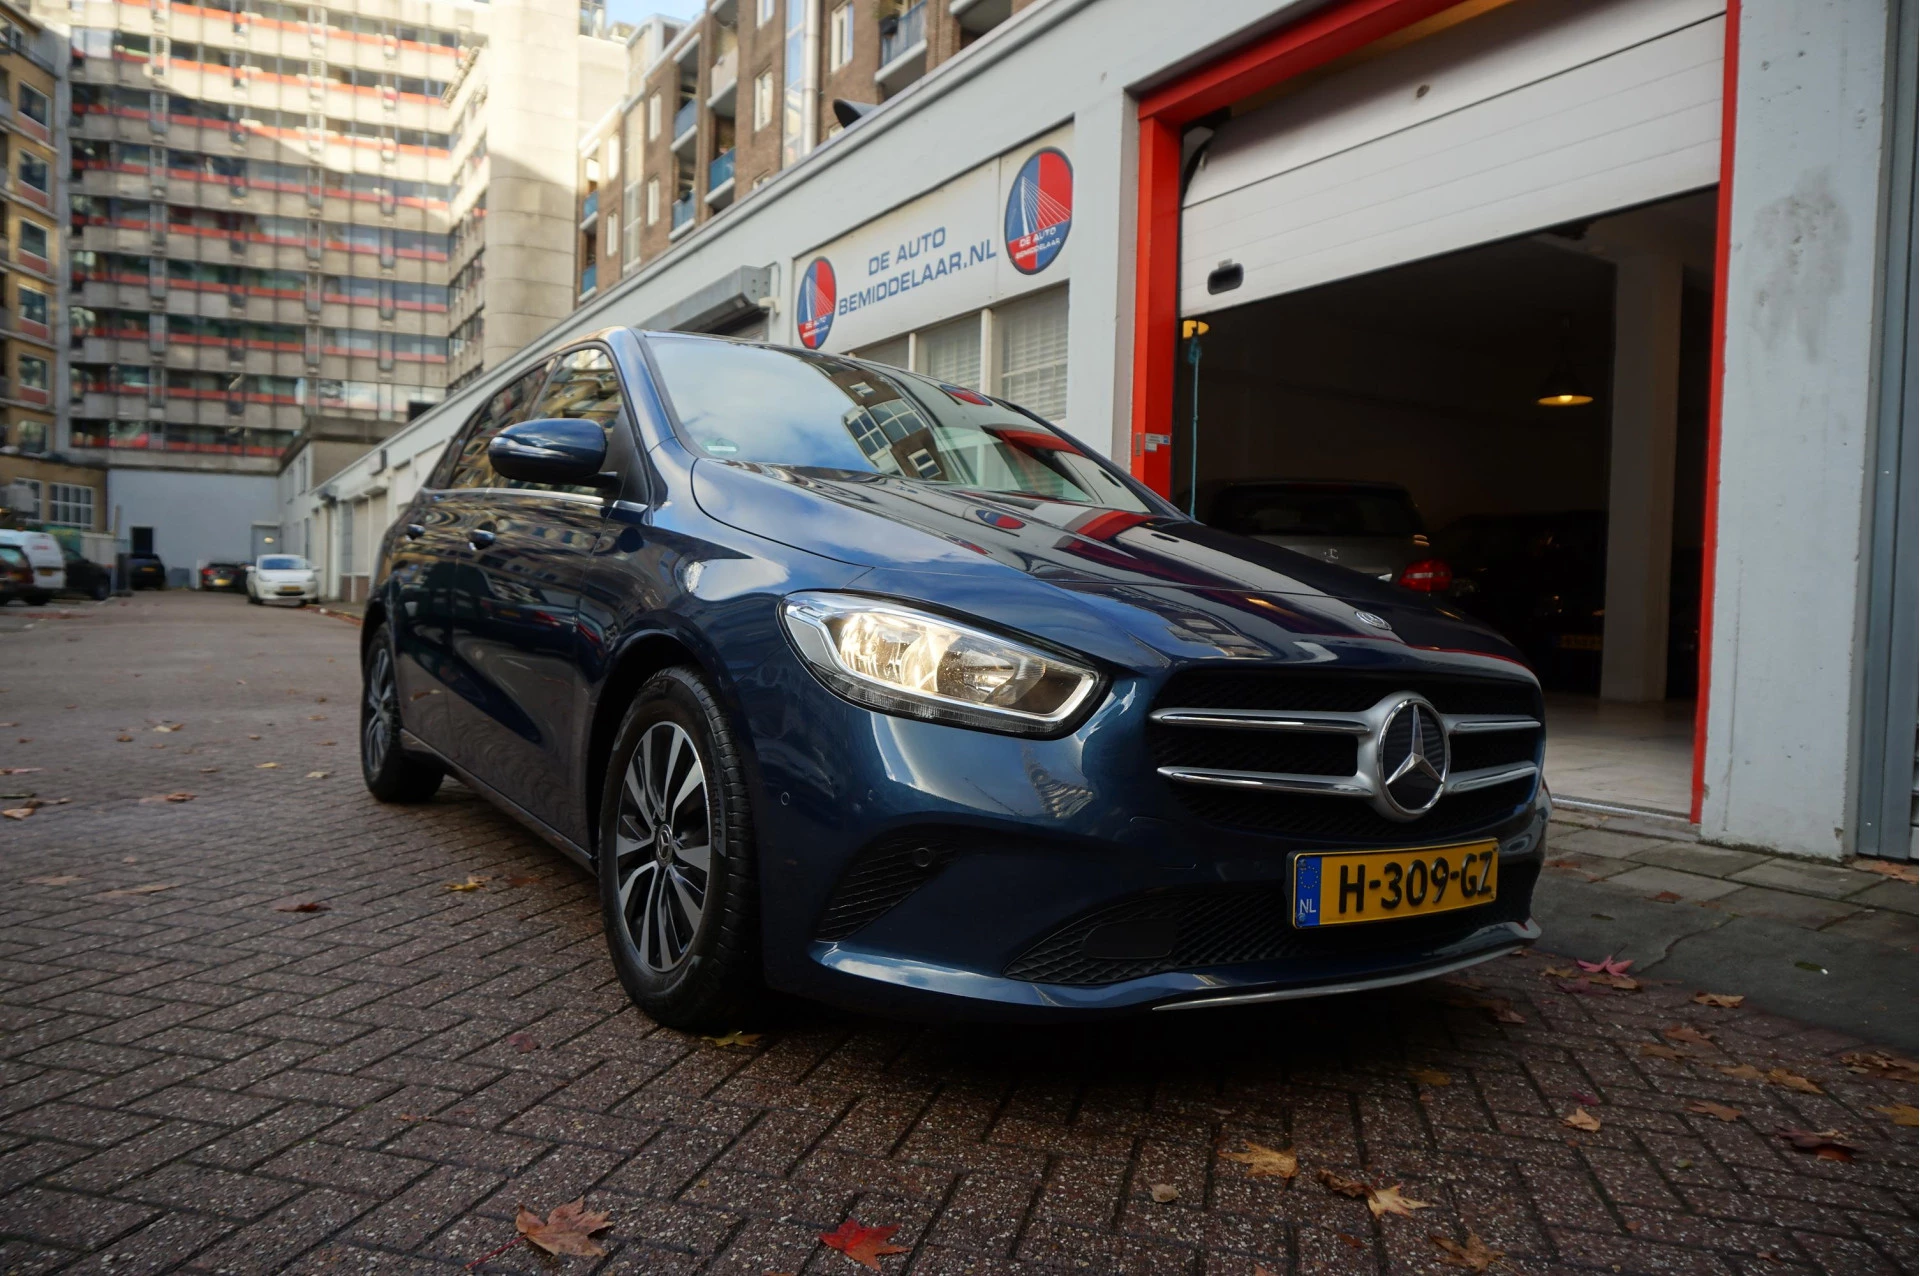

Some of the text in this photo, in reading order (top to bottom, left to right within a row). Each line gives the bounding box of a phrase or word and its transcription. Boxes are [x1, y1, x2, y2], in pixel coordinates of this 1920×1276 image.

[868, 226, 946, 276] DE AUTO
[1019, 226, 1057, 248] DE AUTO
[838, 239, 997, 316] BEMIDDELAAR.NL
[1299, 898, 1317, 914] NL
[1339, 851, 1493, 914] H-309-GZ
